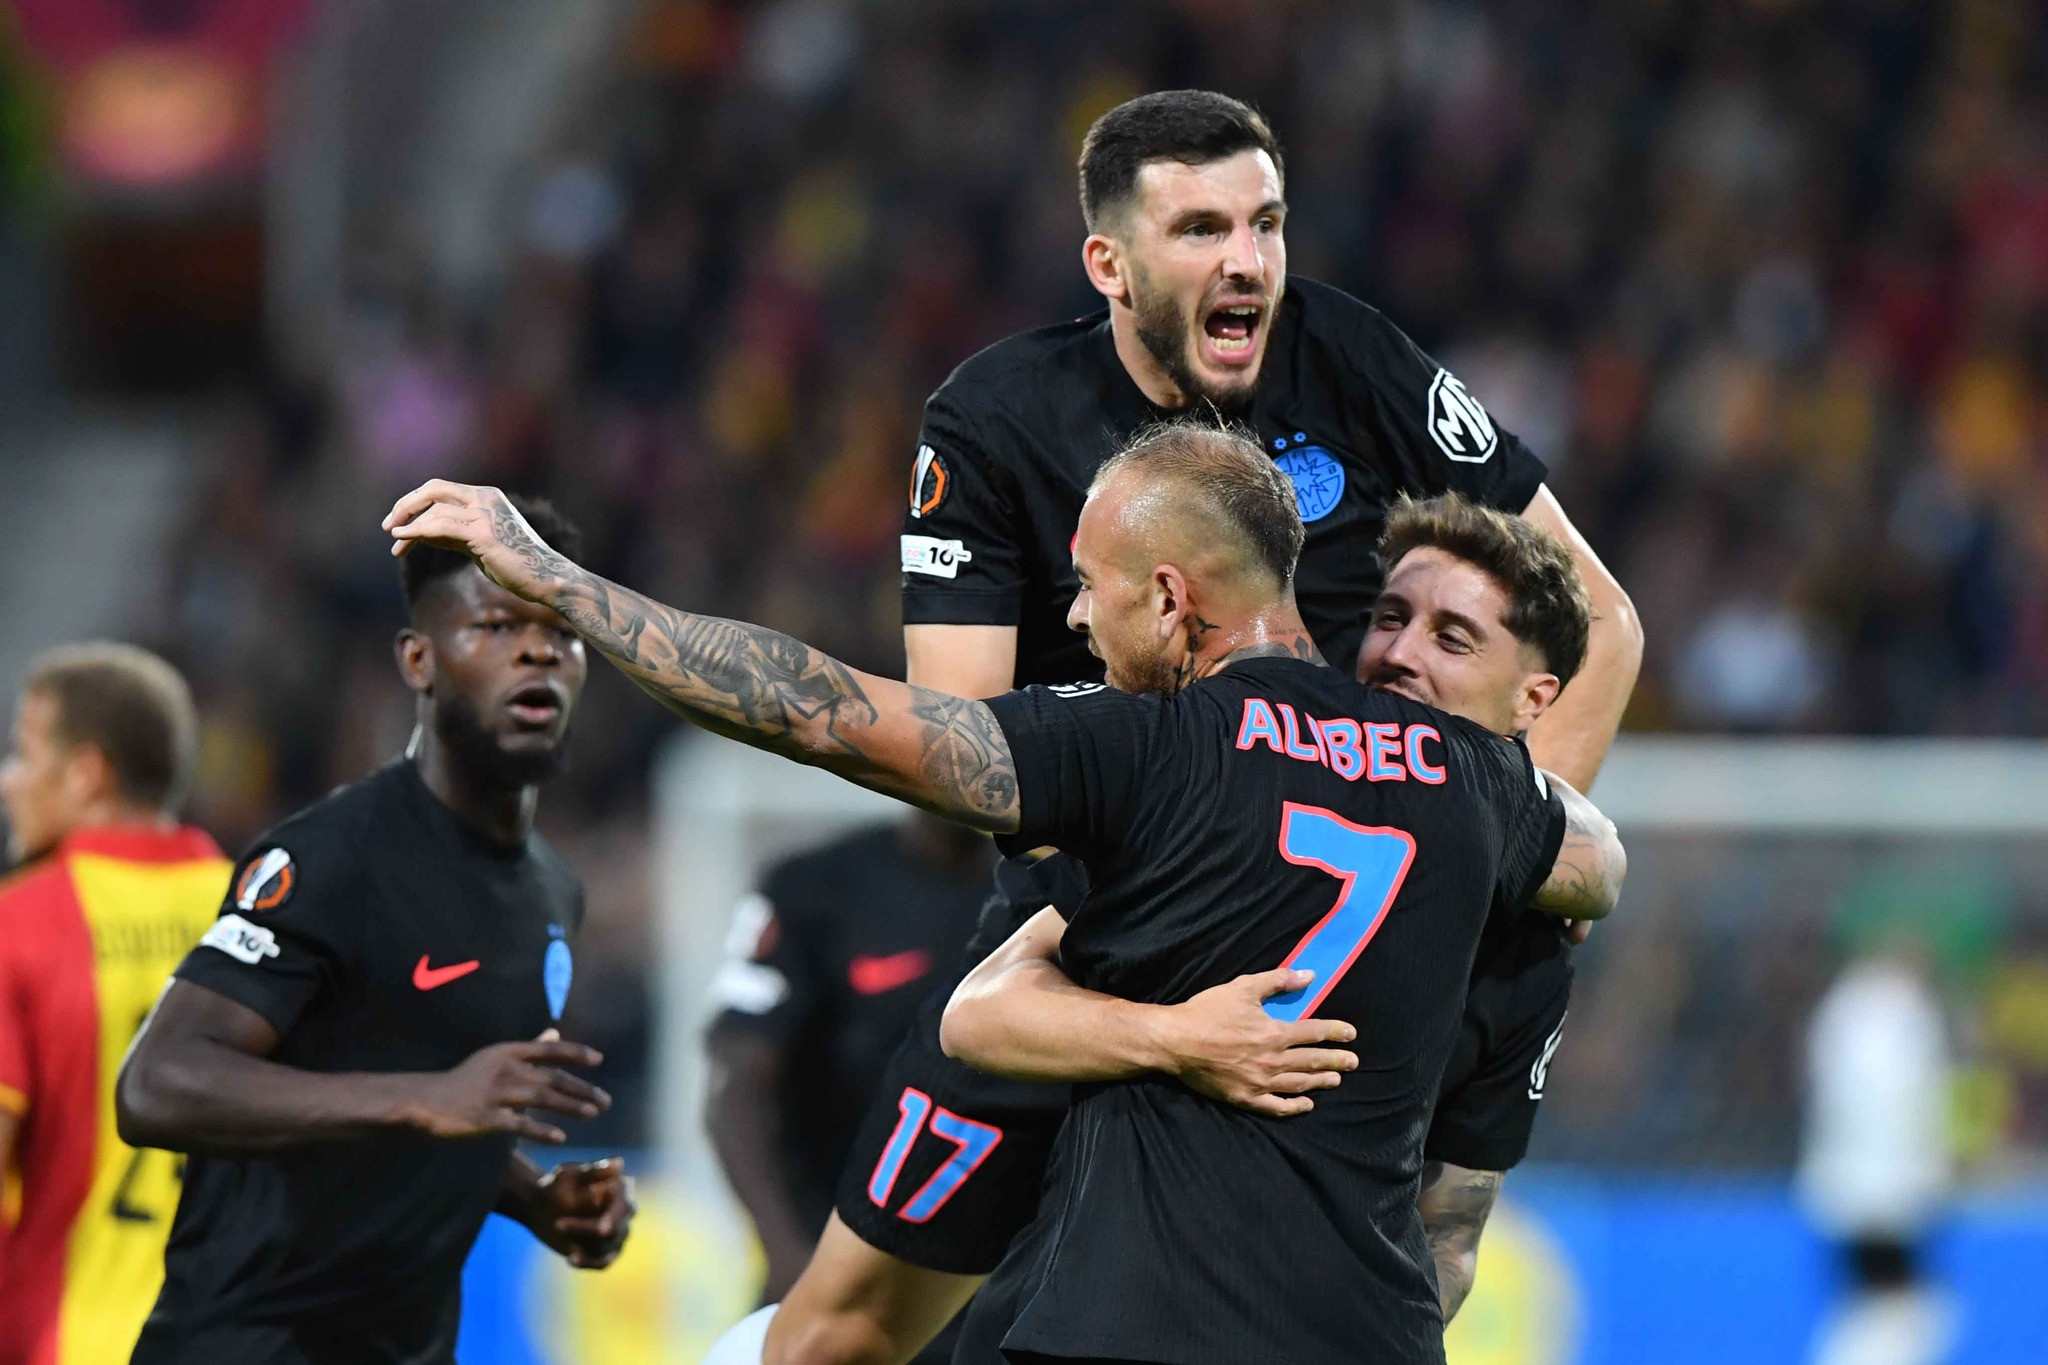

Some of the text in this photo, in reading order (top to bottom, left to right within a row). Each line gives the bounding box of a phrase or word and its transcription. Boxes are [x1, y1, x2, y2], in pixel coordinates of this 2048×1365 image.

[929, 546, 955, 567] 10
[1235, 698, 1447, 785] ALIBEC
[1256, 800, 1417, 1023] 7
[867, 1086, 1004, 1225] 17
